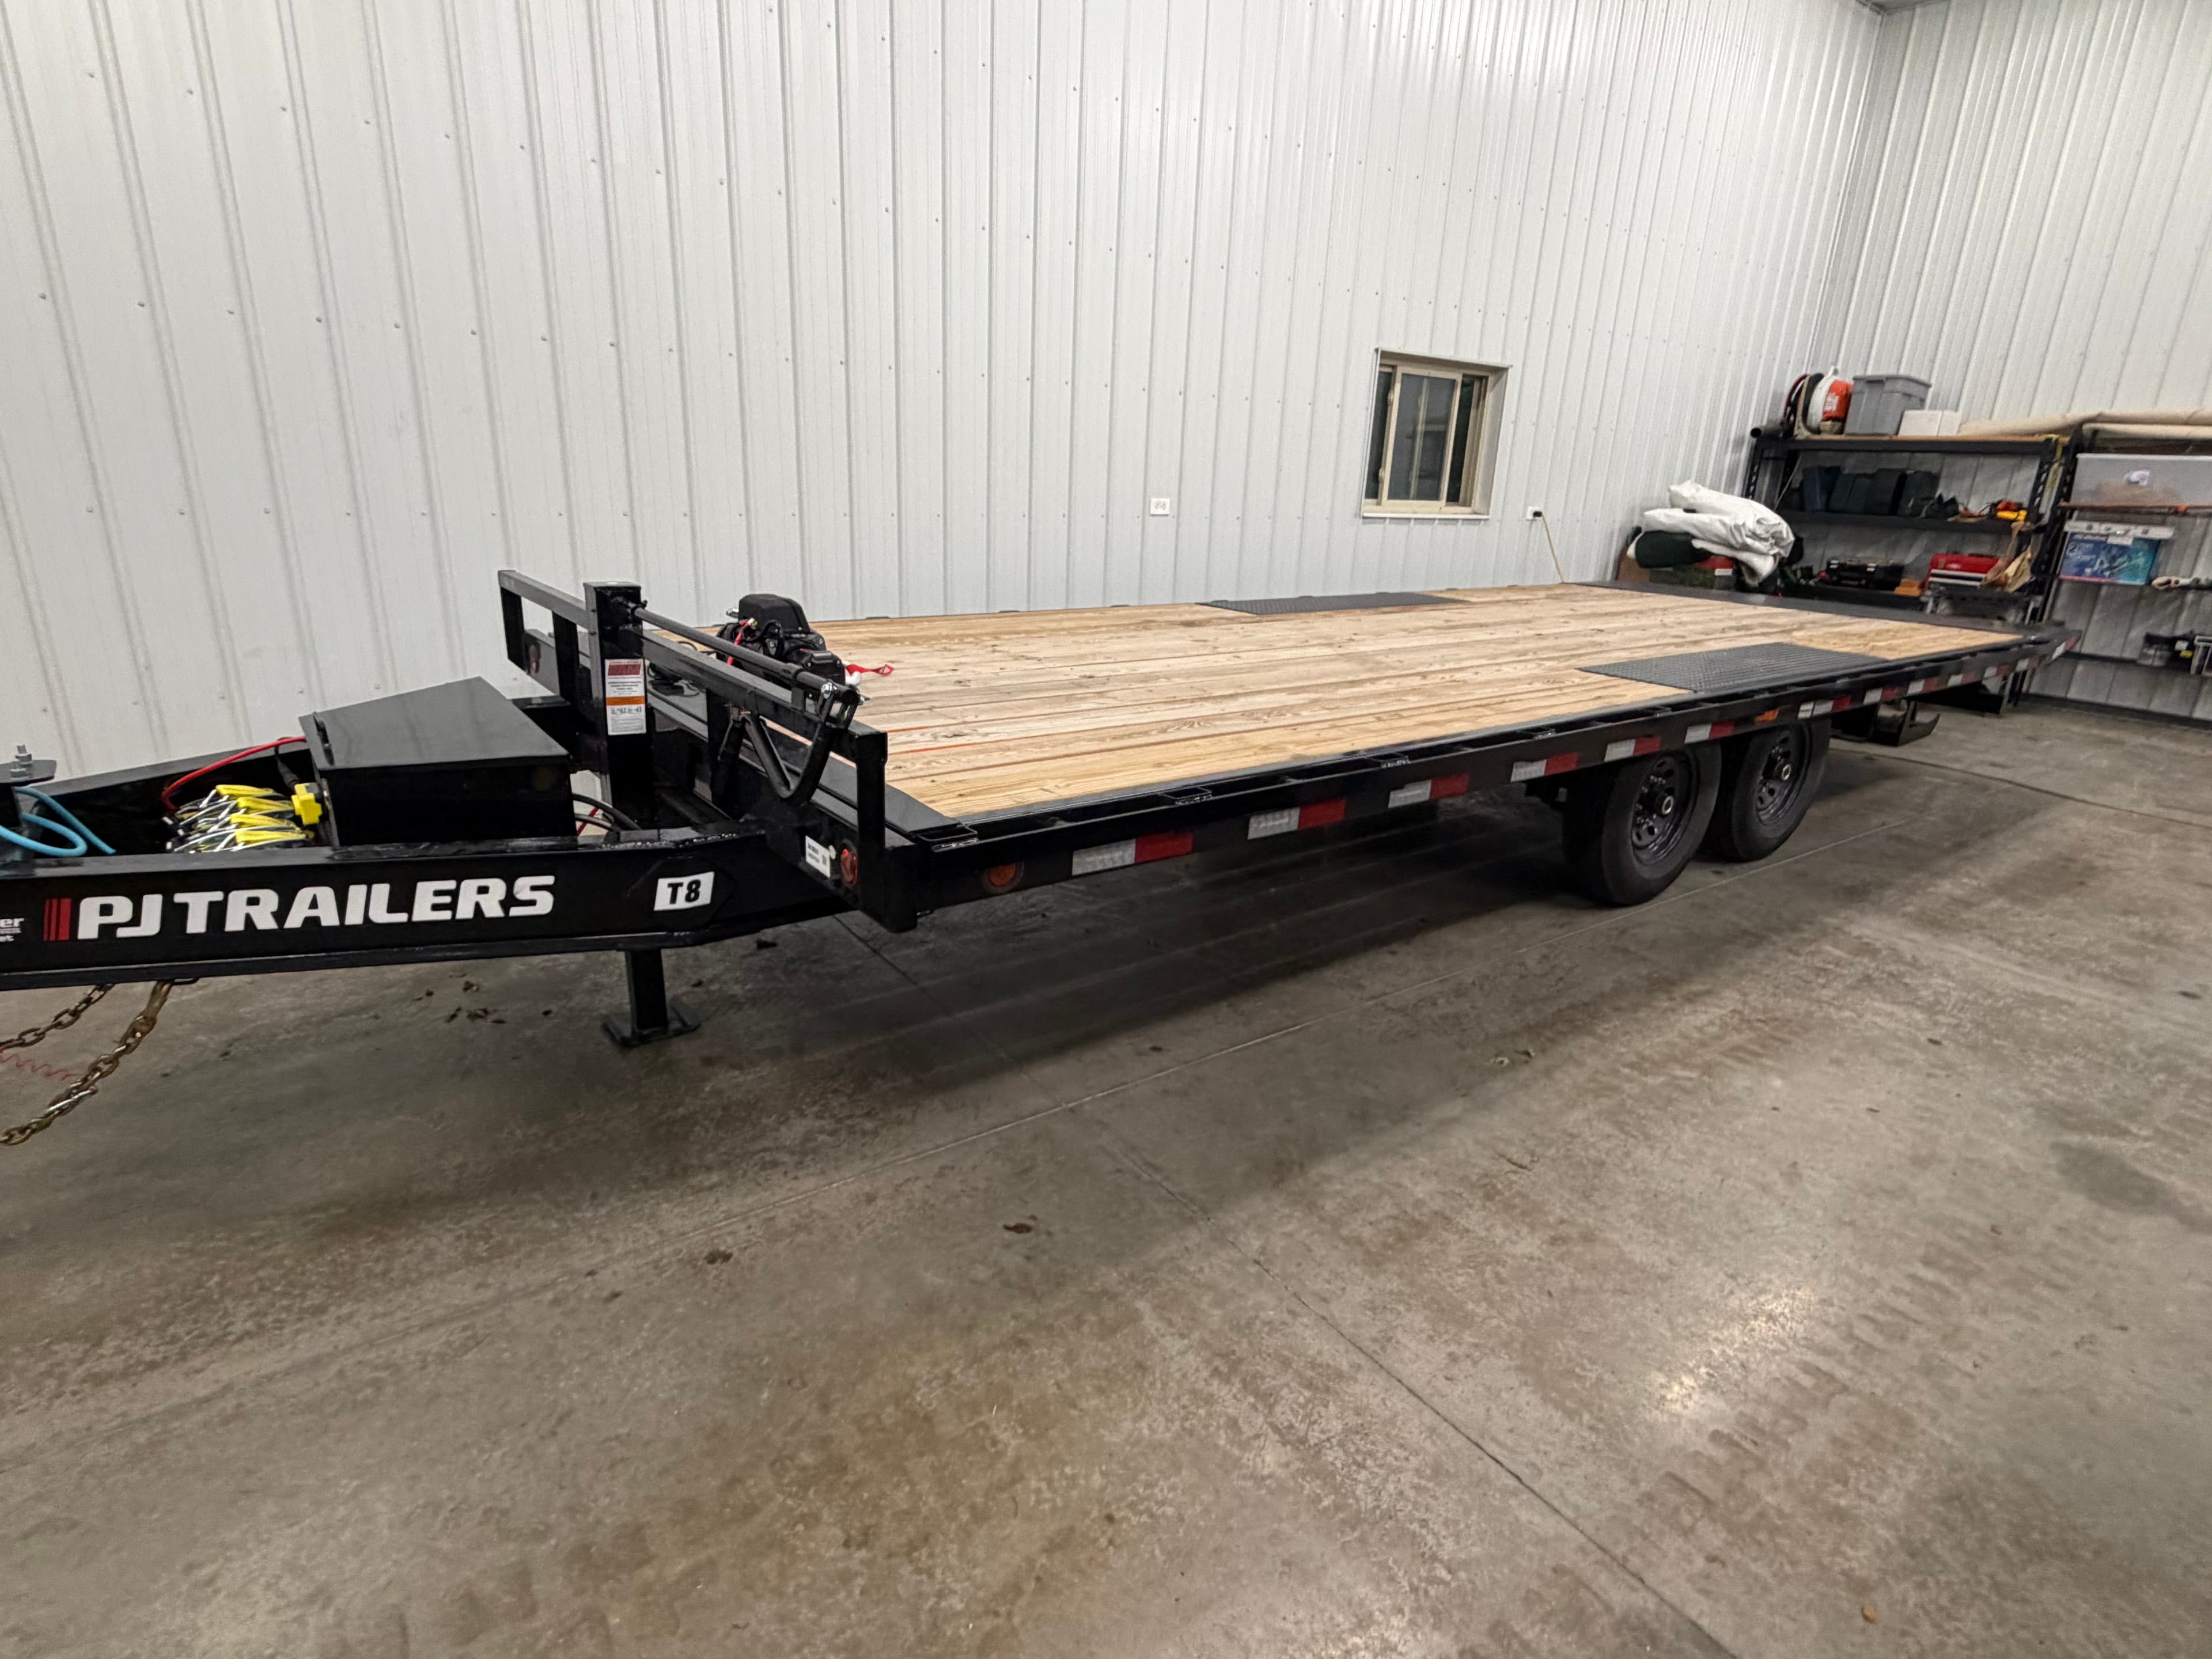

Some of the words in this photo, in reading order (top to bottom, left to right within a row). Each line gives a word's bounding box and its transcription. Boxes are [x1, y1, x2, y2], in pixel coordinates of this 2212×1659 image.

[78, 893, 163, 940] PJ
[173, 875, 555, 934] TRAILERS
[667, 879, 701, 905] T8
